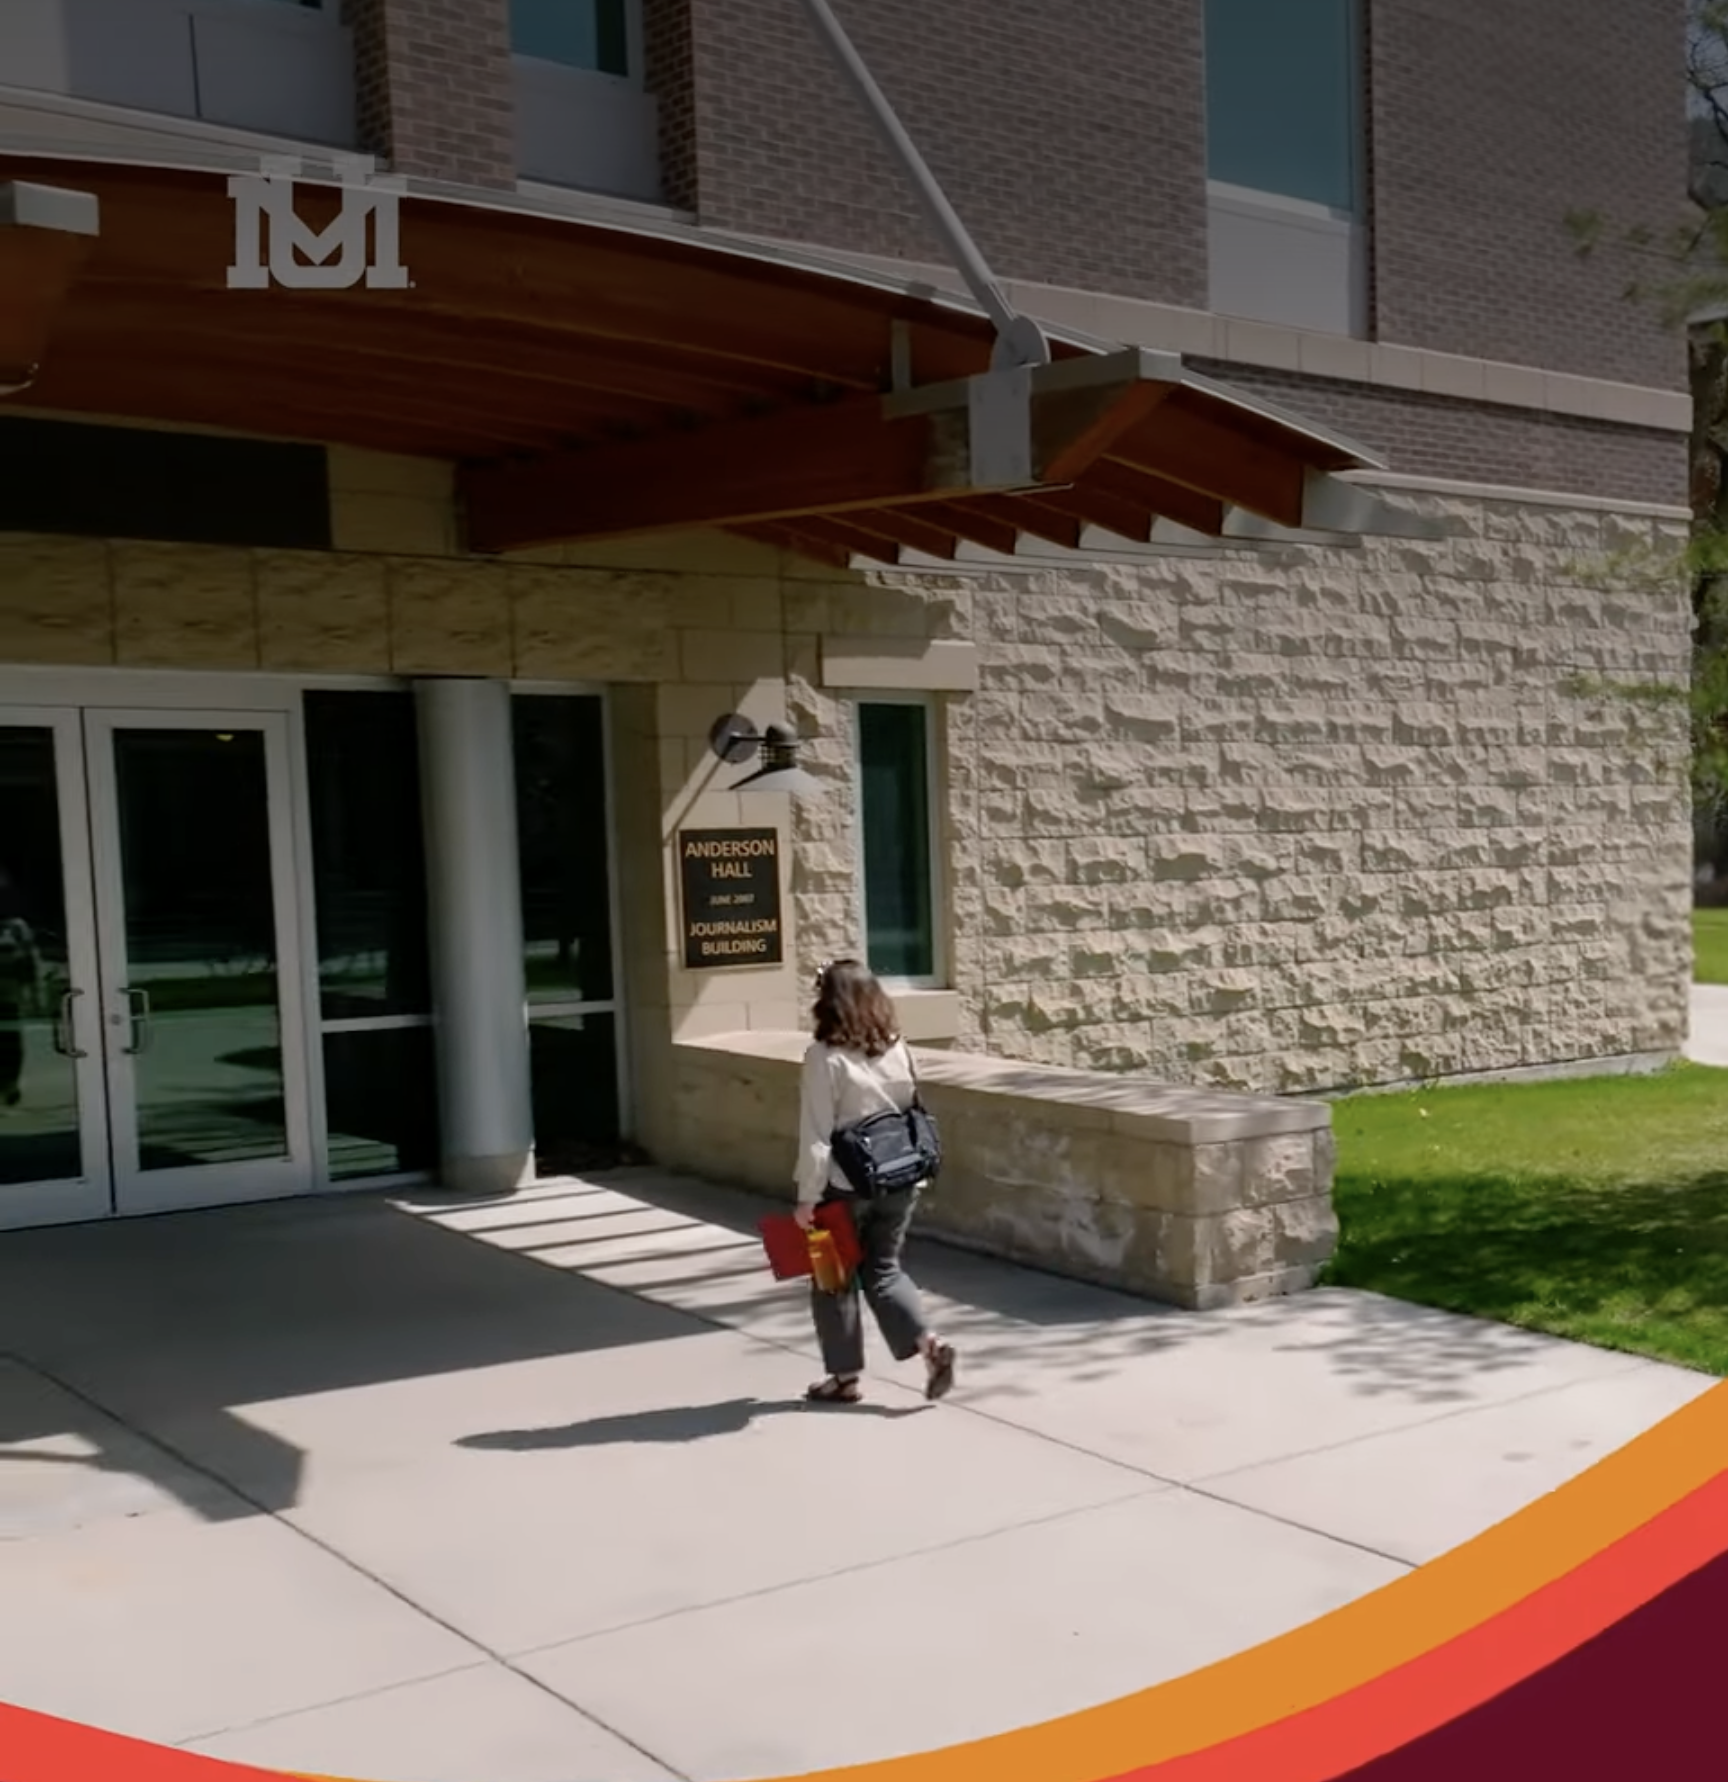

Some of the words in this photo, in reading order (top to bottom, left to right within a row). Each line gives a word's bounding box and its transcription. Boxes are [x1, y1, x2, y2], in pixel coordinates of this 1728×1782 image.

[685, 839, 775, 858] ANDERSON
[711, 862, 752, 878] HALL
[690, 919, 777, 936] JOURNALISM
[702, 939, 767, 955] BUILDING
